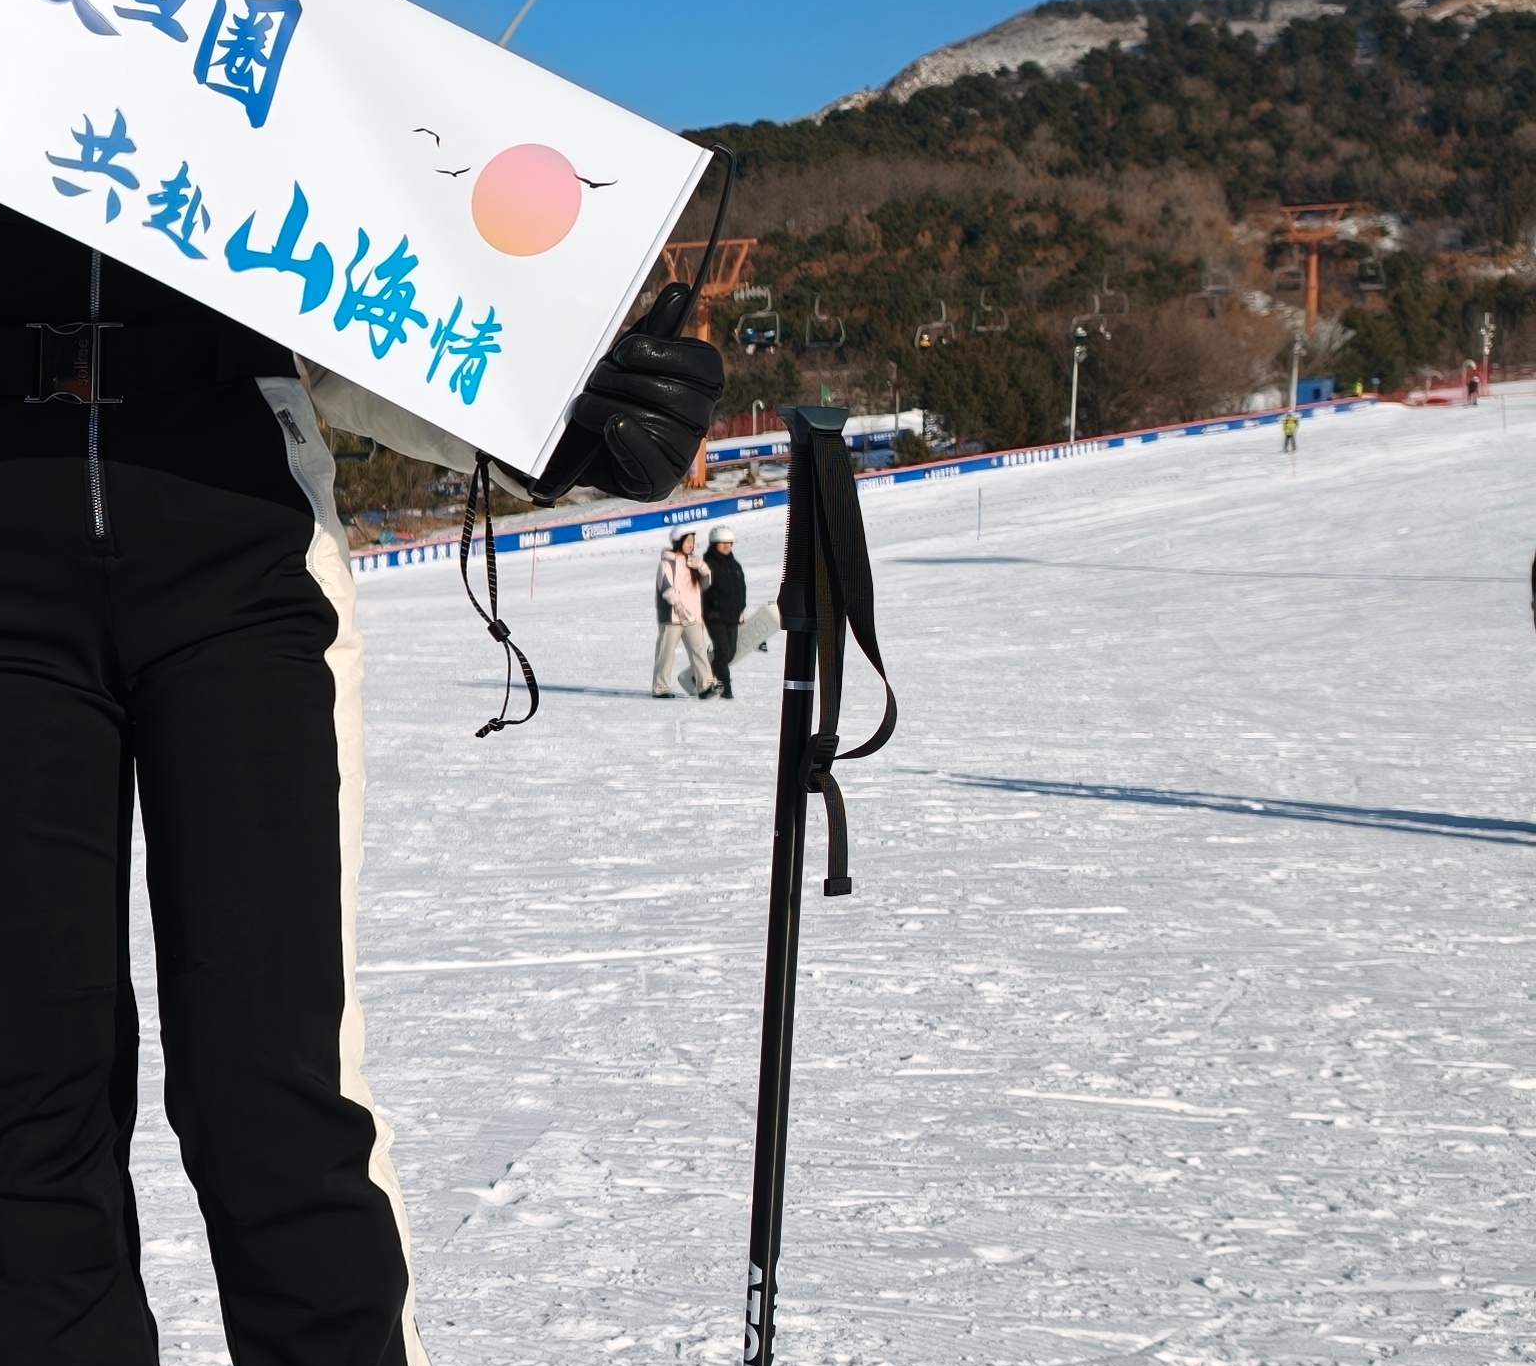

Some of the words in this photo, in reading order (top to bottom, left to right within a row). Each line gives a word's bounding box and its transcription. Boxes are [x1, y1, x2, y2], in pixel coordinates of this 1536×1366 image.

[46, 109, 502, 405] 共赴山海情
